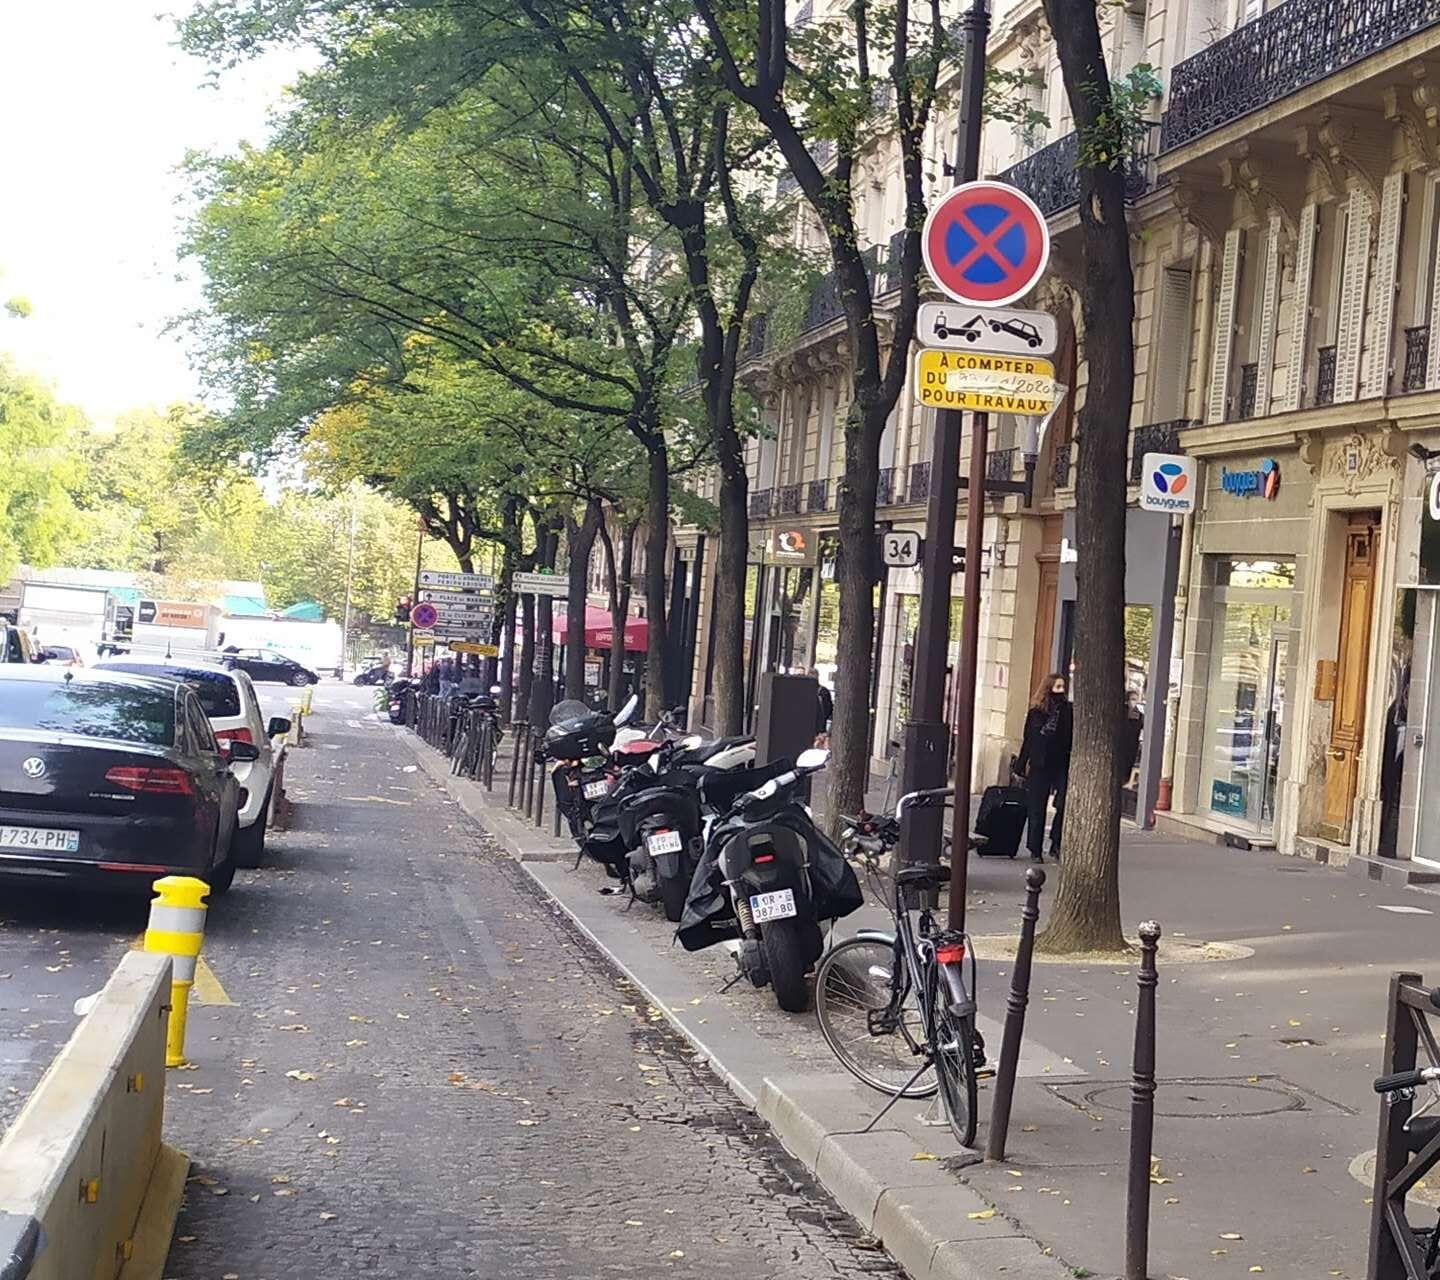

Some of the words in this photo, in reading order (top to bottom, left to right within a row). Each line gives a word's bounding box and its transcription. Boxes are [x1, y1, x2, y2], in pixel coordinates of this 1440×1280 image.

[940, 352, 949, 369] À
[956, 356, 1034, 375] COMPTER
[926, 372, 947, 385] DU
[922, 389, 967, 405] POUR
[975, 394, 1048, 412] TRAVAUX
[1145, 494, 1190, 509] bouygues
[889, 539, 912, 558] 34
